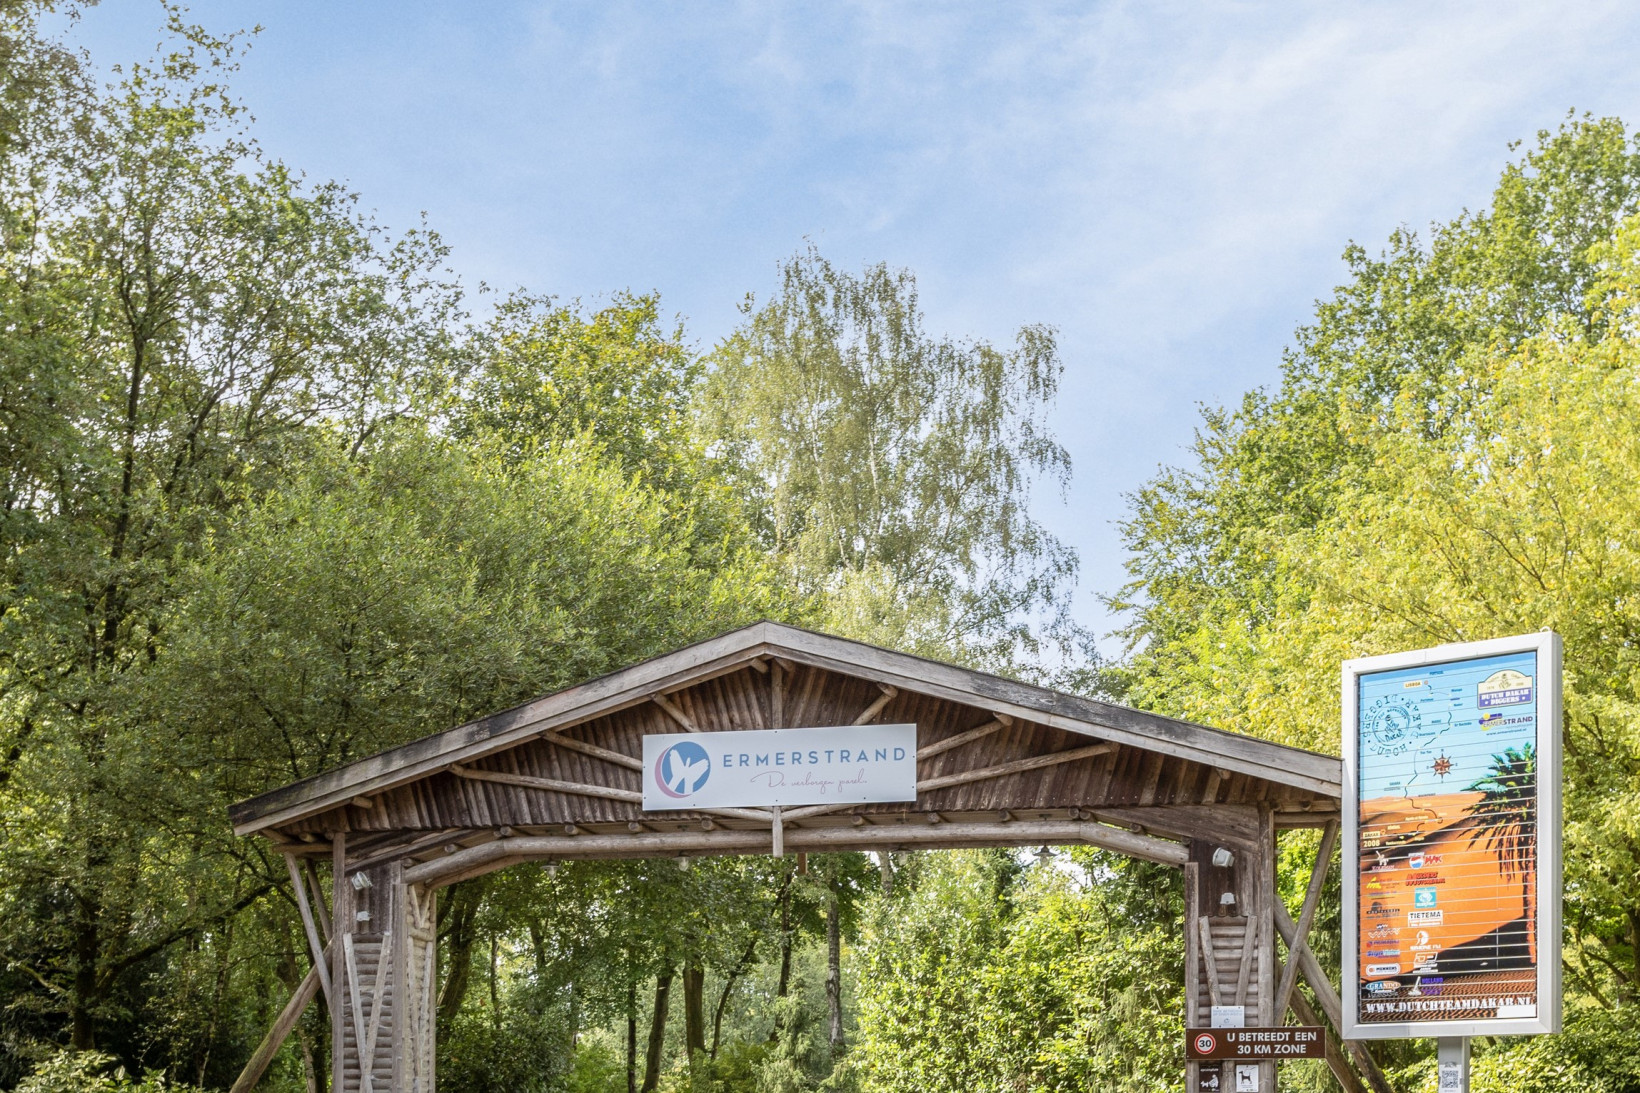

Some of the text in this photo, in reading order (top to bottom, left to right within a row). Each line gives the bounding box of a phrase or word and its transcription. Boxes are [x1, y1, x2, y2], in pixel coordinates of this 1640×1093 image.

[1481, 688, 1530, 701] DUTCH DAKAR
[1490, 696, 1520, 705] DIGGERS
[1483, 716, 1534, 728] ERMERSTRAND
[723, 747, 906, 768] ERMERSTRAND
[750, 770, 786, 788] De
[791, 771, 834, 795] verborgen
[1409, 911, 1441, 919] TIETEMA
[1227, 1032, 1317, 1042] U BETREEDT EEN
[1198, 1039, 1212, 1048] 30
[1237, 1044, 1307, 1055] 30 KM ZONE
